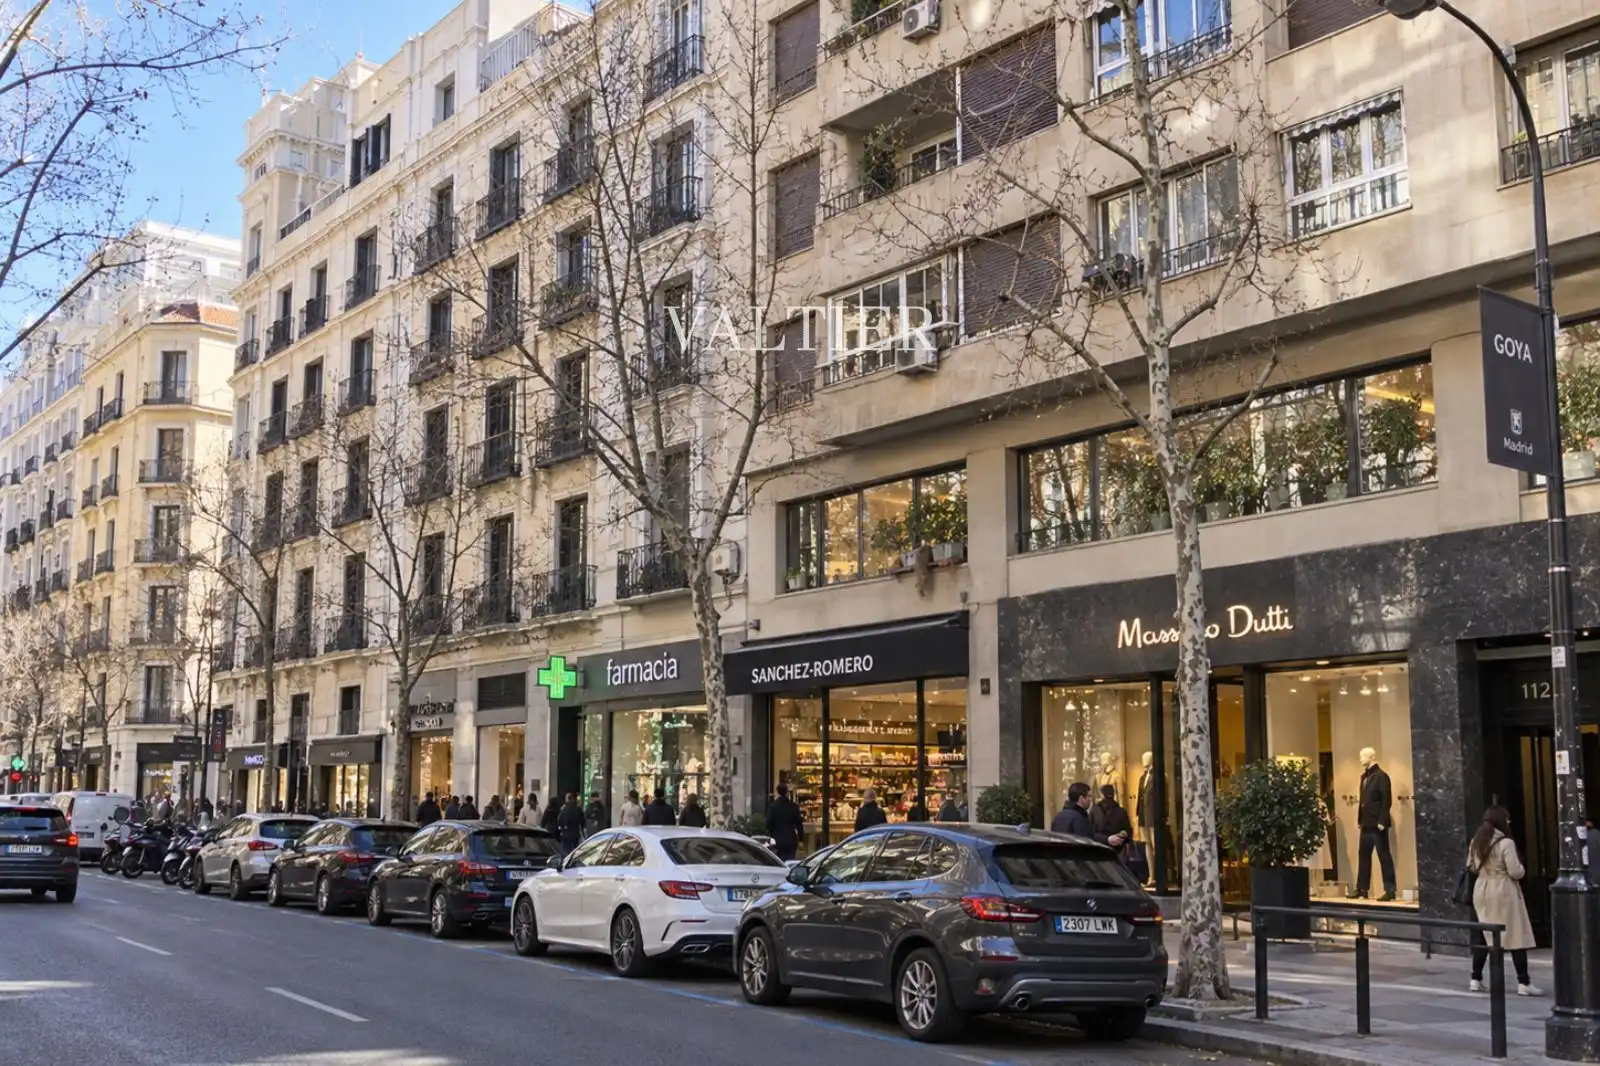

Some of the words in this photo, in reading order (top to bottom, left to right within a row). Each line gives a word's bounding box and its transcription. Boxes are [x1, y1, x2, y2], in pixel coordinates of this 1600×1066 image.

[1494, 333, 1533, 364] GOYA
[1503, 436, 1534, 456] Madrid
[1117, 617, 1221, 649] Masso
[1226, 604, 1294, 638] Dutti
[606, 651, 678, 687] farmacia
[1521, 681, 1551, 700] 112
[1063, 917, 1091, 931] 2307
